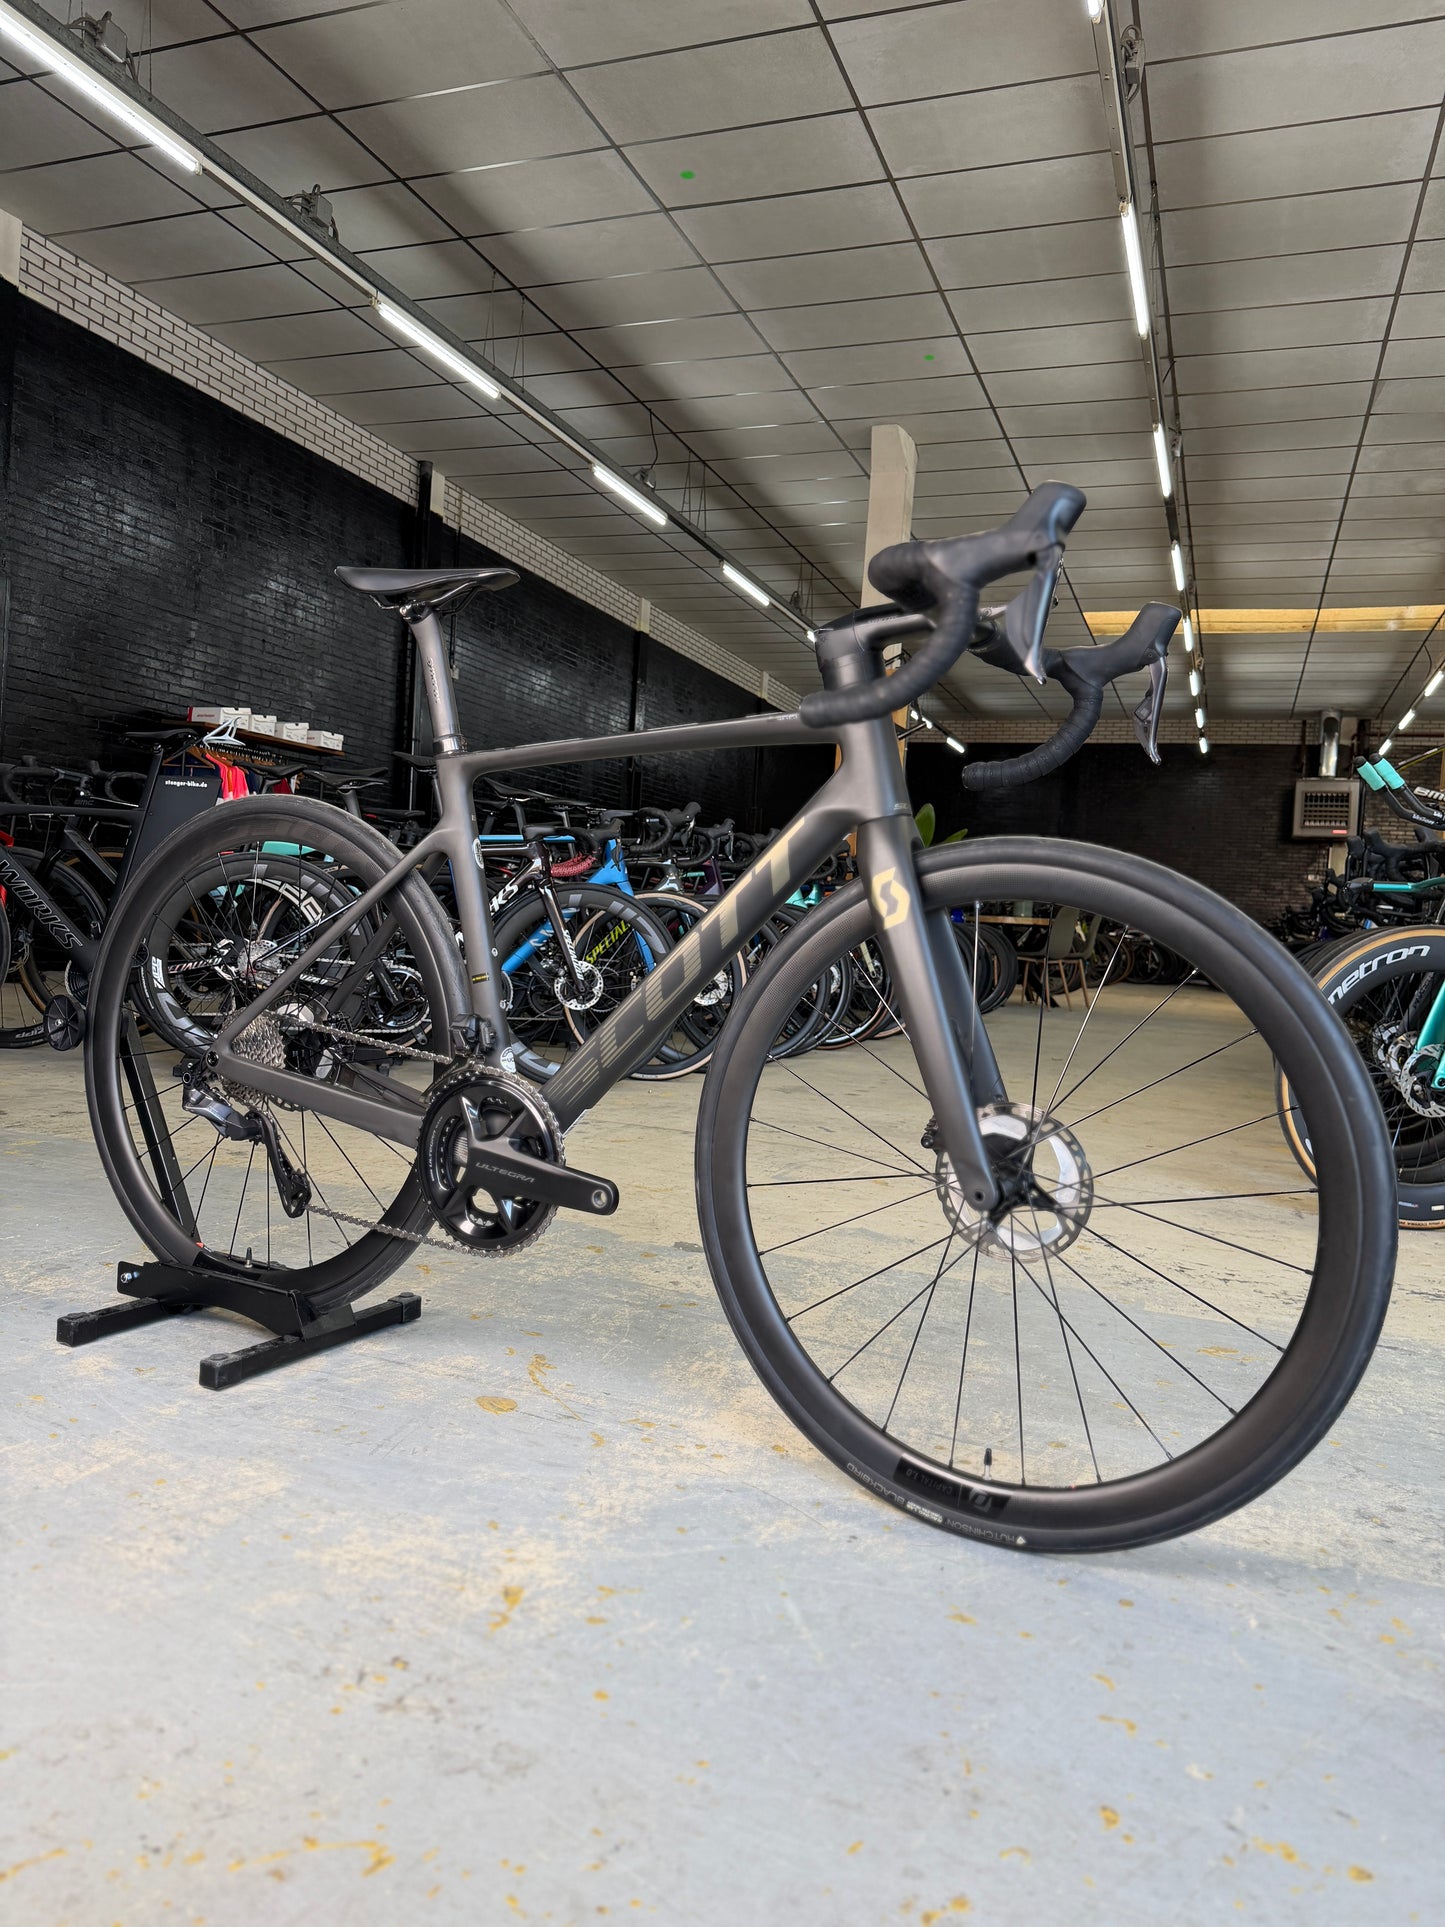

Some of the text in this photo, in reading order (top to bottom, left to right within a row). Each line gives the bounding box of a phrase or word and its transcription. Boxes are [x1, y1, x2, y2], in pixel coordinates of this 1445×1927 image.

[475, 1161, 536, 1184] ULTEGRA
[846, 1461, 905, 1505] BLACKBIRD
[949, 1518, 1015, 1545] HUTCHINSON
